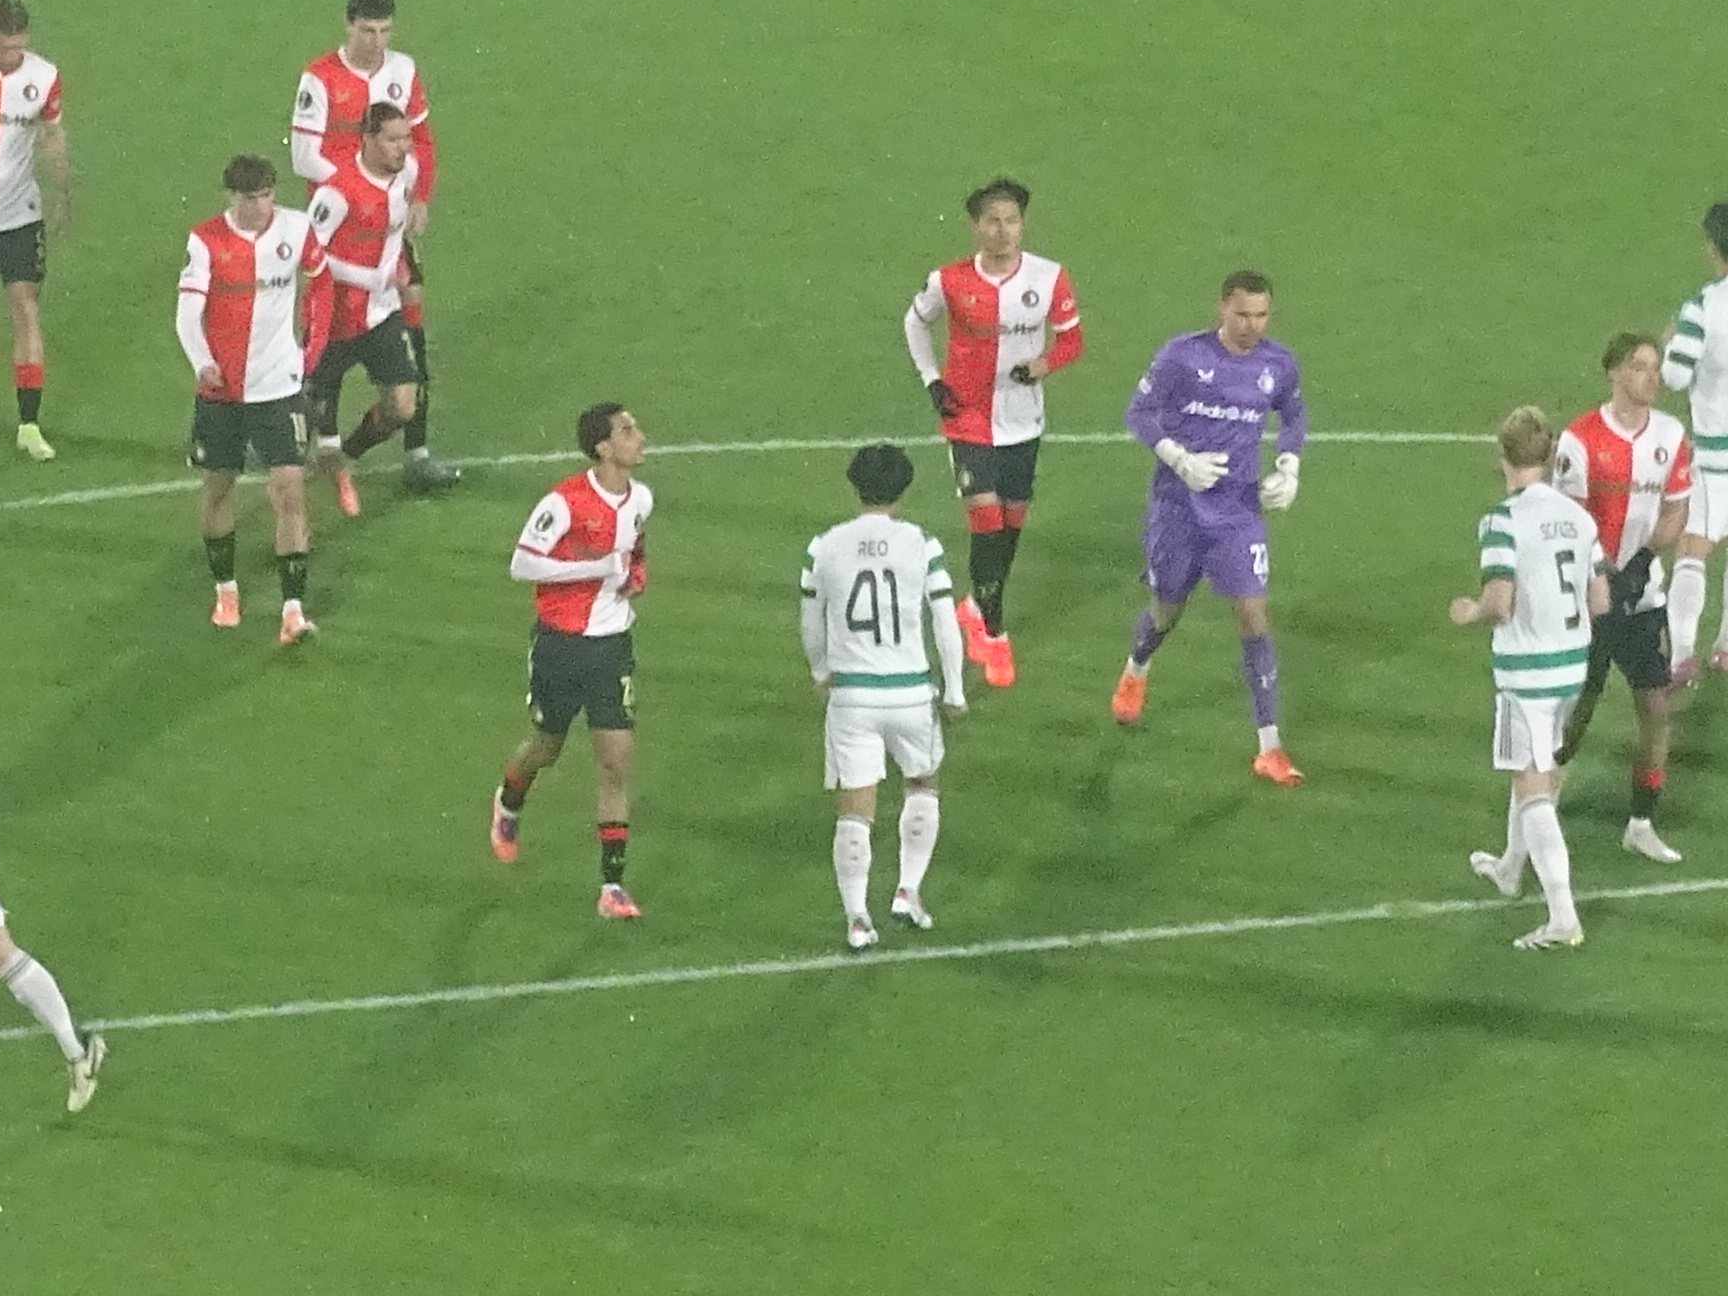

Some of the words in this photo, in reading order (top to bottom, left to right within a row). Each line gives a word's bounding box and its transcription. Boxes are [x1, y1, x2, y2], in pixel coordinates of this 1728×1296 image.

[858, 540, 888, 557] REO
[846, 570, 901, 645] 41
[1555, 549, 1580, 630] 5
